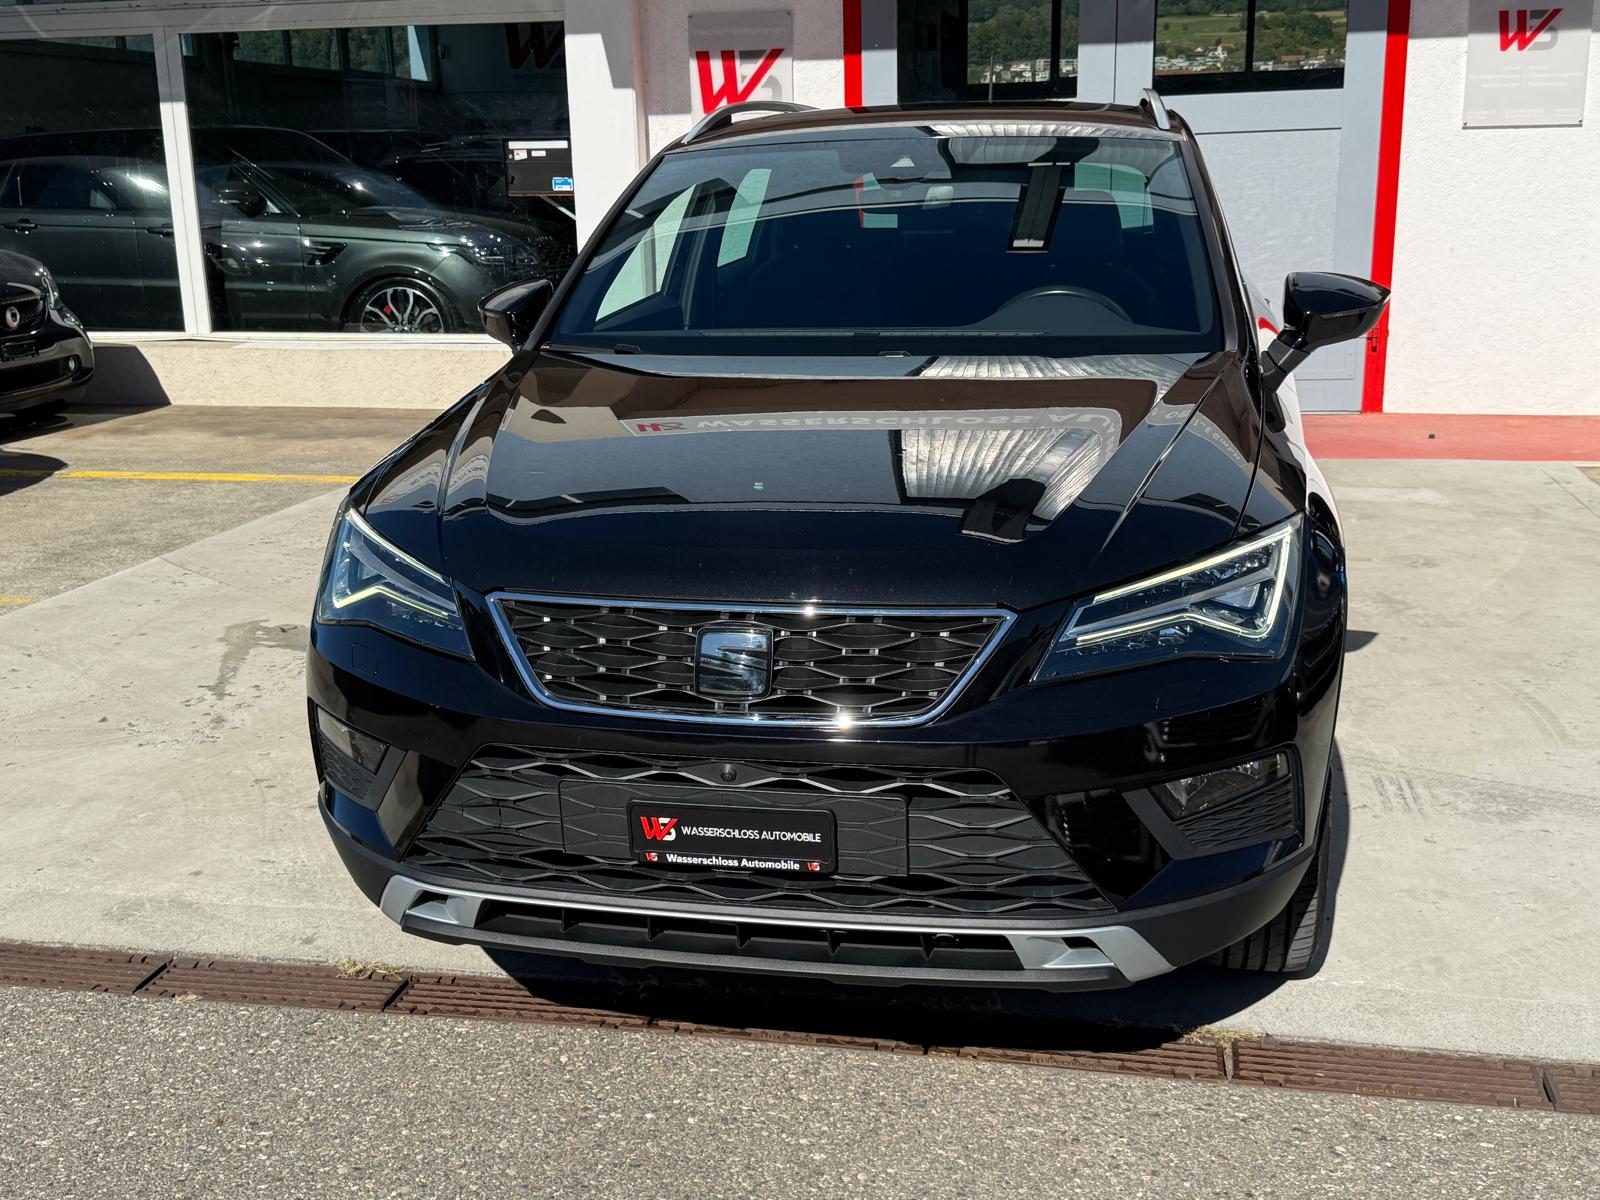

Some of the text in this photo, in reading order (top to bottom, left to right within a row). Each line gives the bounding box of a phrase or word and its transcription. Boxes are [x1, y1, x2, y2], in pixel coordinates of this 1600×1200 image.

[681, 825, 760, 840] WASSERSCHLOSS
[761, 830, 822, 843] AUTOMOBILE
[666, 853, 739, 867] Wasserschloss
[740, 857, 800, 870] Automobile
